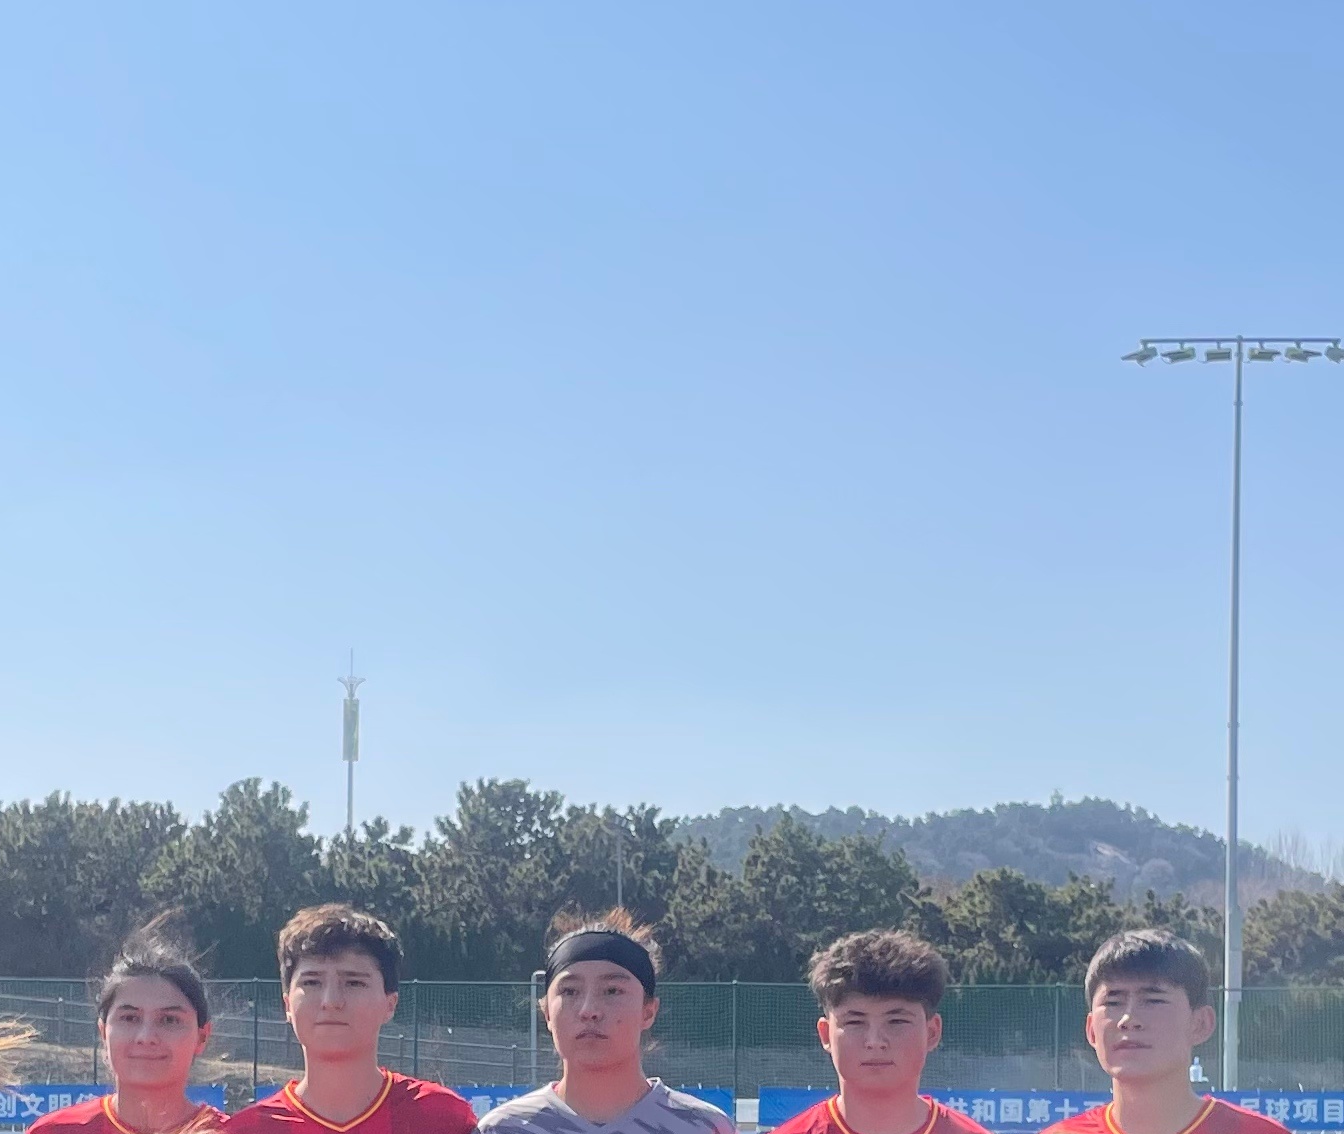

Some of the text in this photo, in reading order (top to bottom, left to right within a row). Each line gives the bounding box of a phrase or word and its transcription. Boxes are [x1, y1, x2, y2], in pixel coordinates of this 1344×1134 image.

[945, 1097, 1105, 1123] 共和国第十
